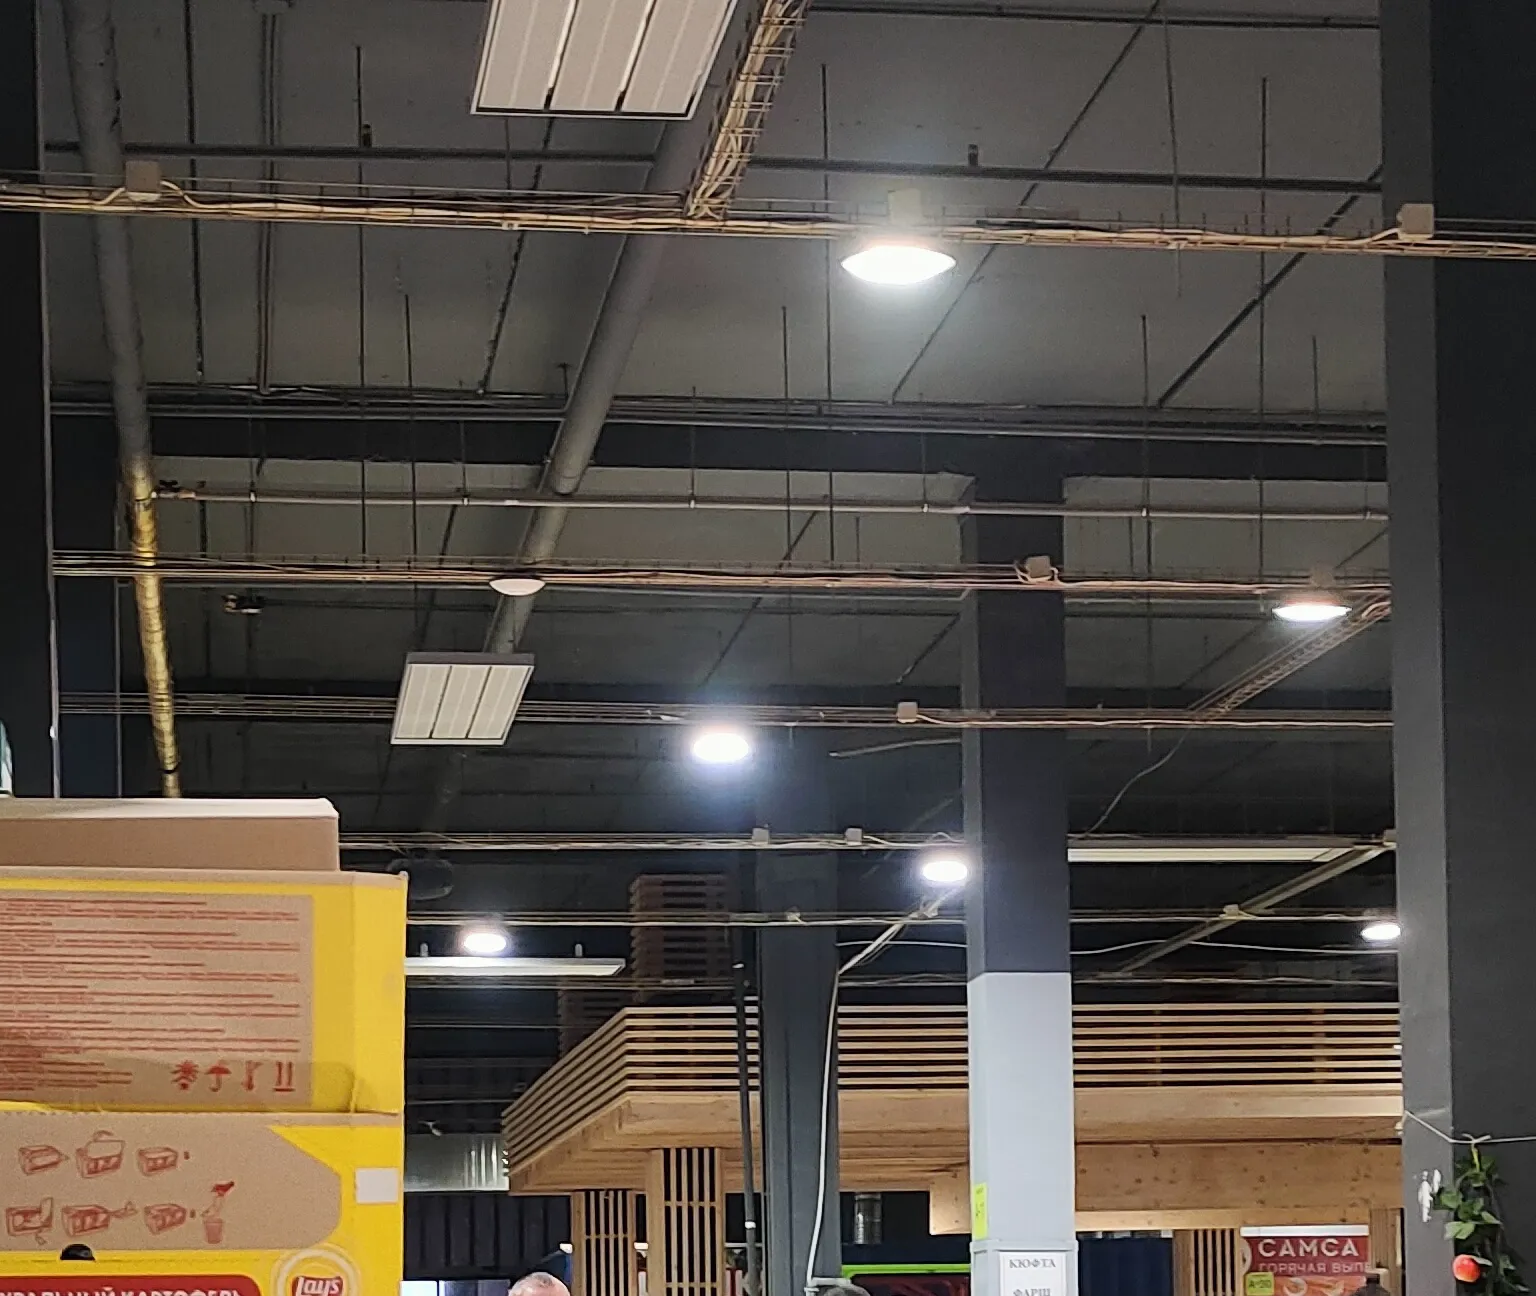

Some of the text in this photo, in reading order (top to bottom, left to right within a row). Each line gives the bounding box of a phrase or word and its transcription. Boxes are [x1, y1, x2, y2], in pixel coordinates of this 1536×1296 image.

[1257, 1238, 1360, 1257] САМСА
[1008, 1258, 1057, 1269] КЮФТА
[1259, 1262, 1368, 1273] ГОРЯЧАЯ ВЫП
